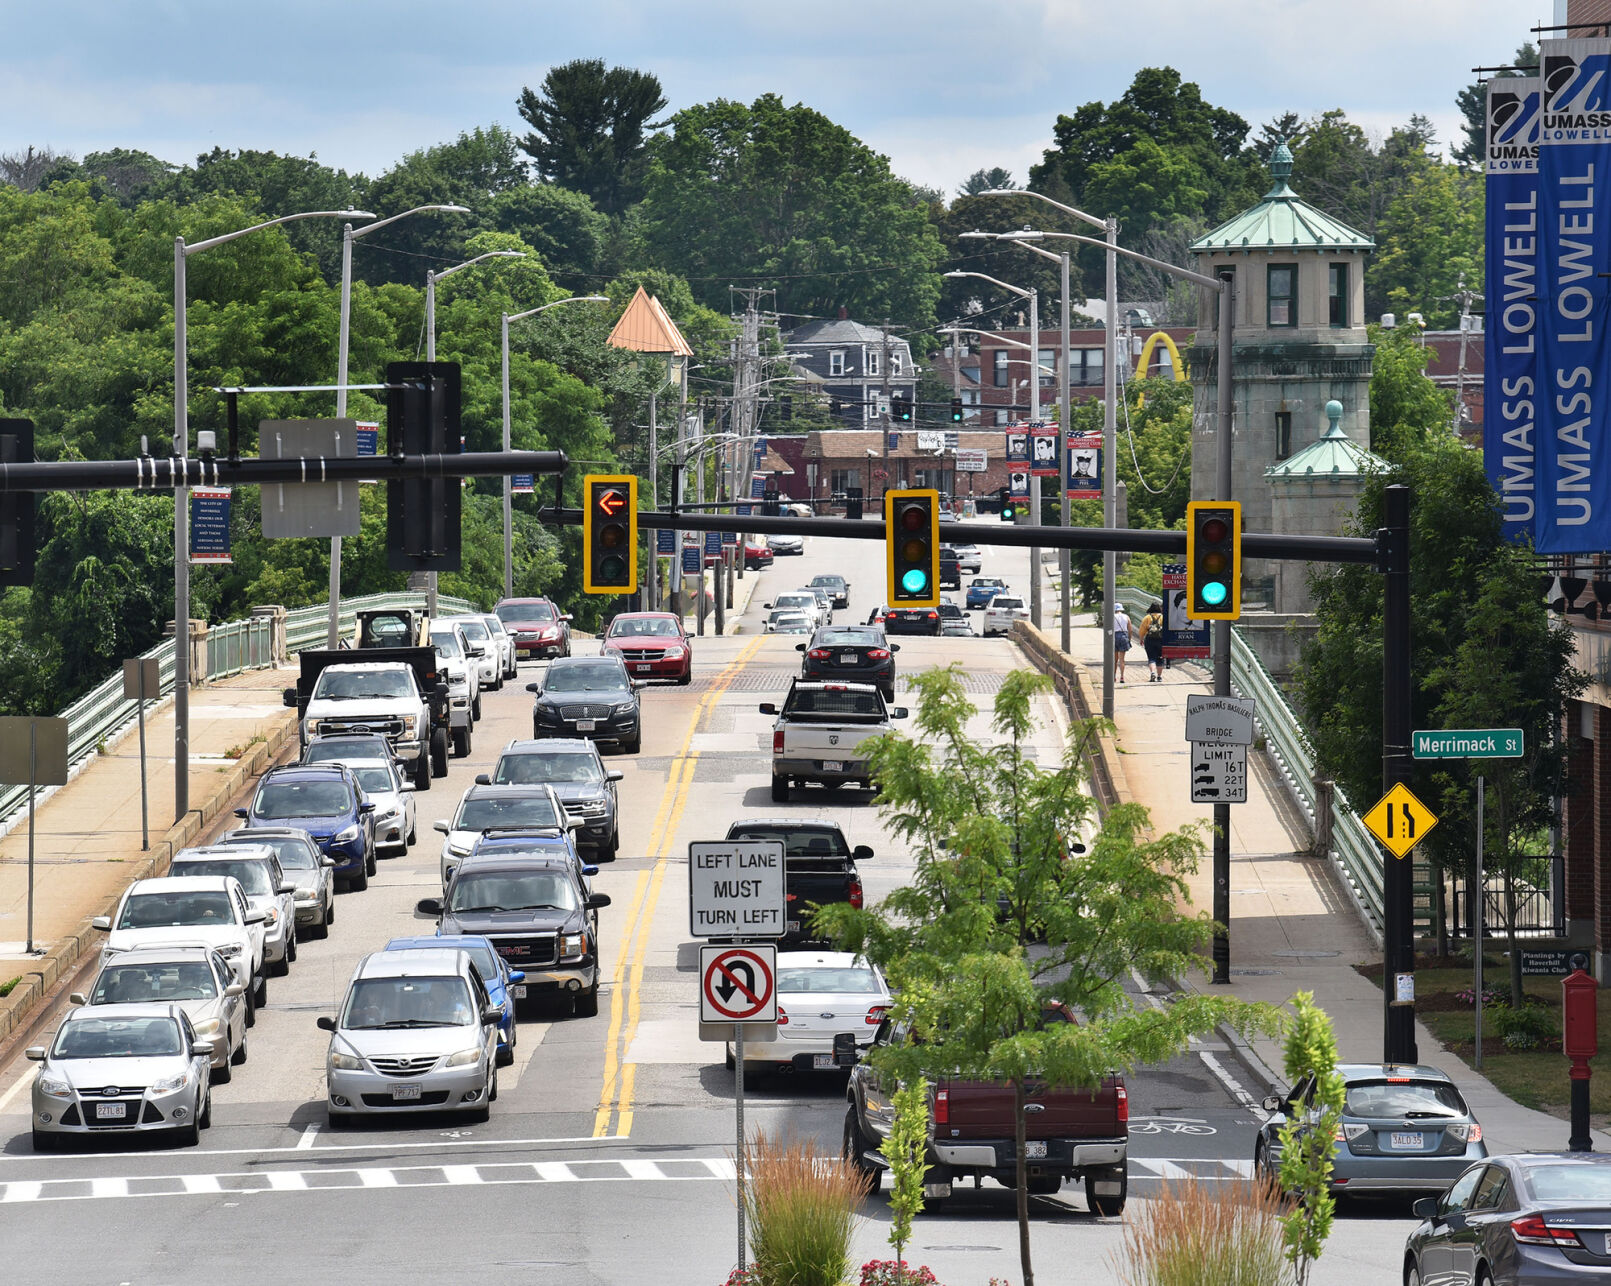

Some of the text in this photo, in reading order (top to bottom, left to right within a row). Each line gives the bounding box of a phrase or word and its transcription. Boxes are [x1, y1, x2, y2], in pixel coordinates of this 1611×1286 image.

[1543, 113, 1611, 129] UMASS
[1543, 129, 1611, 140] LOWELL
[1490, 146, 1540, 159] UMAS
[1489, 160, 1539, 170] LOWE
[1556, 163, 1594, 526] UMASS LOWELL
[1502, 190, 1537, 522] UMASS LOWELL
[1189, 700, 1252, 719] RALPH THOMAS BASILIERE
[1205, 727, 1233, 737] BRIDGE
[1419, 736, 1517, 753] Merrimack St
[1204, 751, 1234, 760] LIMIT
[697, 854, 777, 868] LEFT LANE
[713, 880, 762, 898] MUST
[697, 910, 779, 924] TURN LEFT
[496, 945, 530, 955] GMC
[1412, 1135, 1422, 1145] 35
